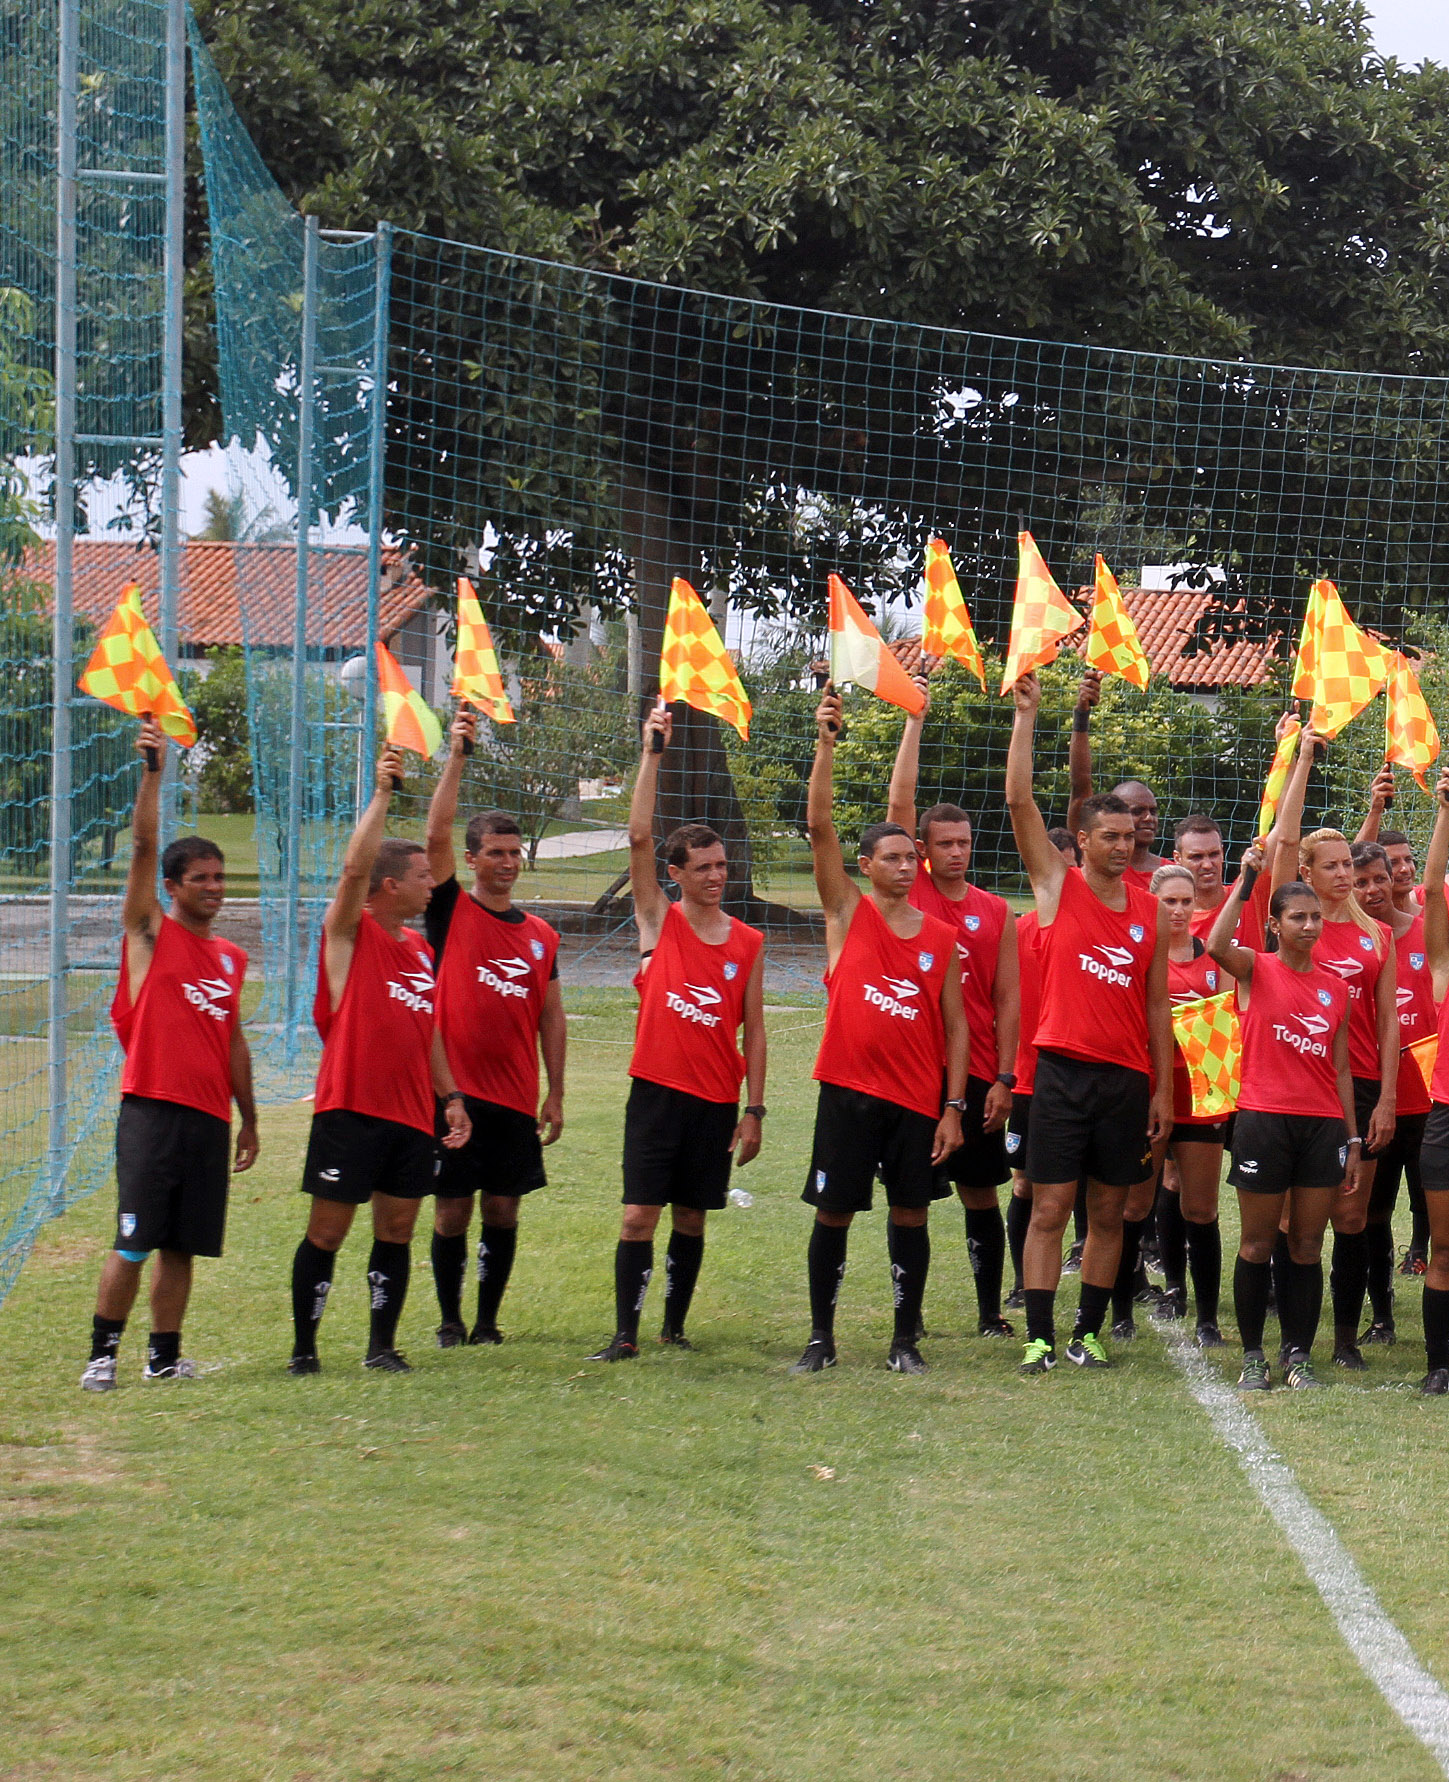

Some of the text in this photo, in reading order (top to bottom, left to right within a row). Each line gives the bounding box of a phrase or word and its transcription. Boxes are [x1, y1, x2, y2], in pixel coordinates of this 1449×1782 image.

[476, 966, 530, 999] Topper
[1078, 953, 1132, 988] Topper
[665, 992, 722, 1027] Topper
[863, 984, 919, 1021] Topper
[1272, 1024, 1328, 1058] Topper
